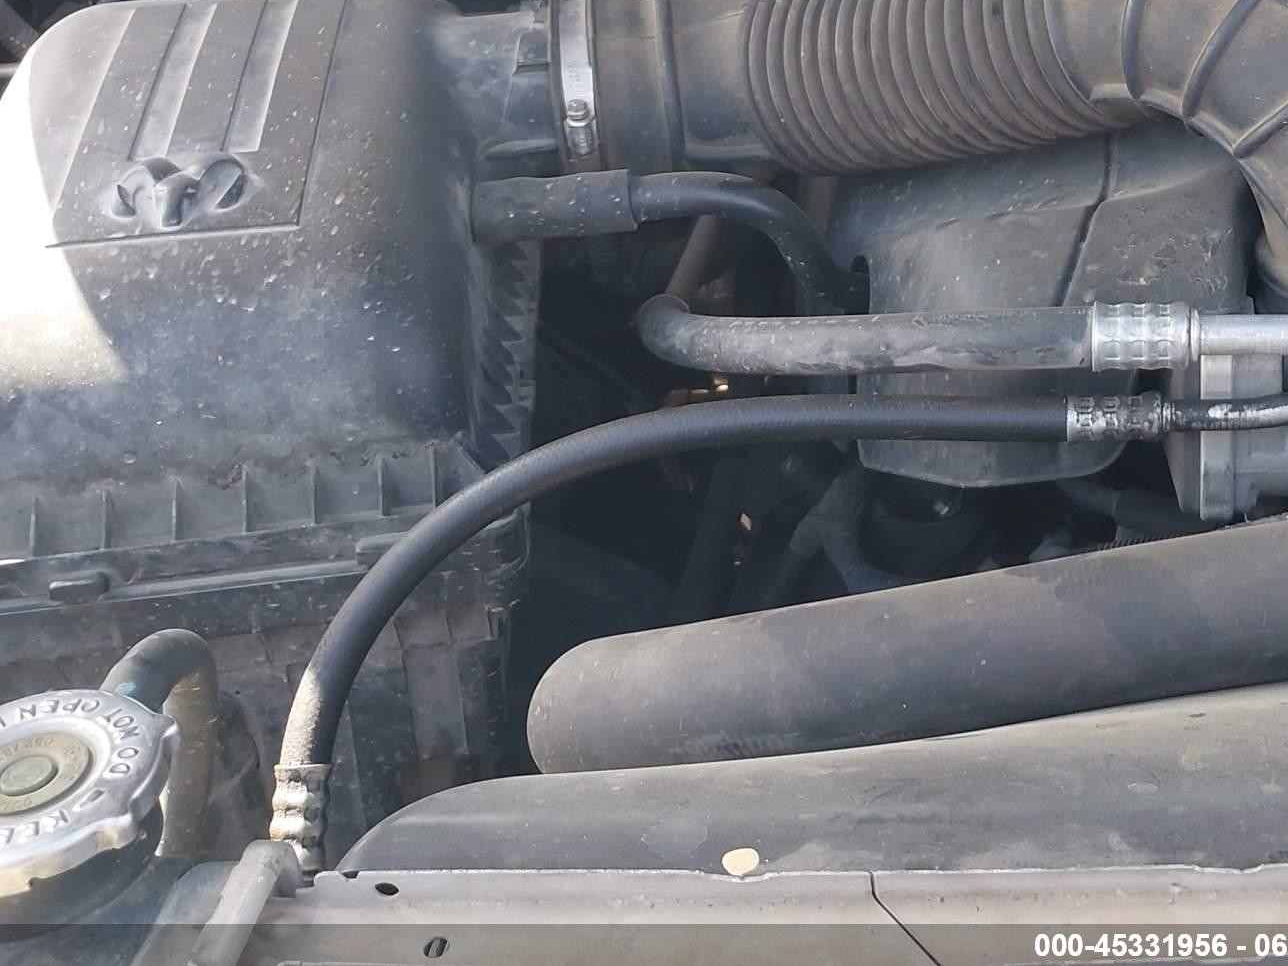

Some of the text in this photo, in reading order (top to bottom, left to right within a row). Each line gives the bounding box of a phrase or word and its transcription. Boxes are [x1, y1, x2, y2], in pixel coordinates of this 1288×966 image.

[19, 698, 141, 776] DO NOT OPEN
